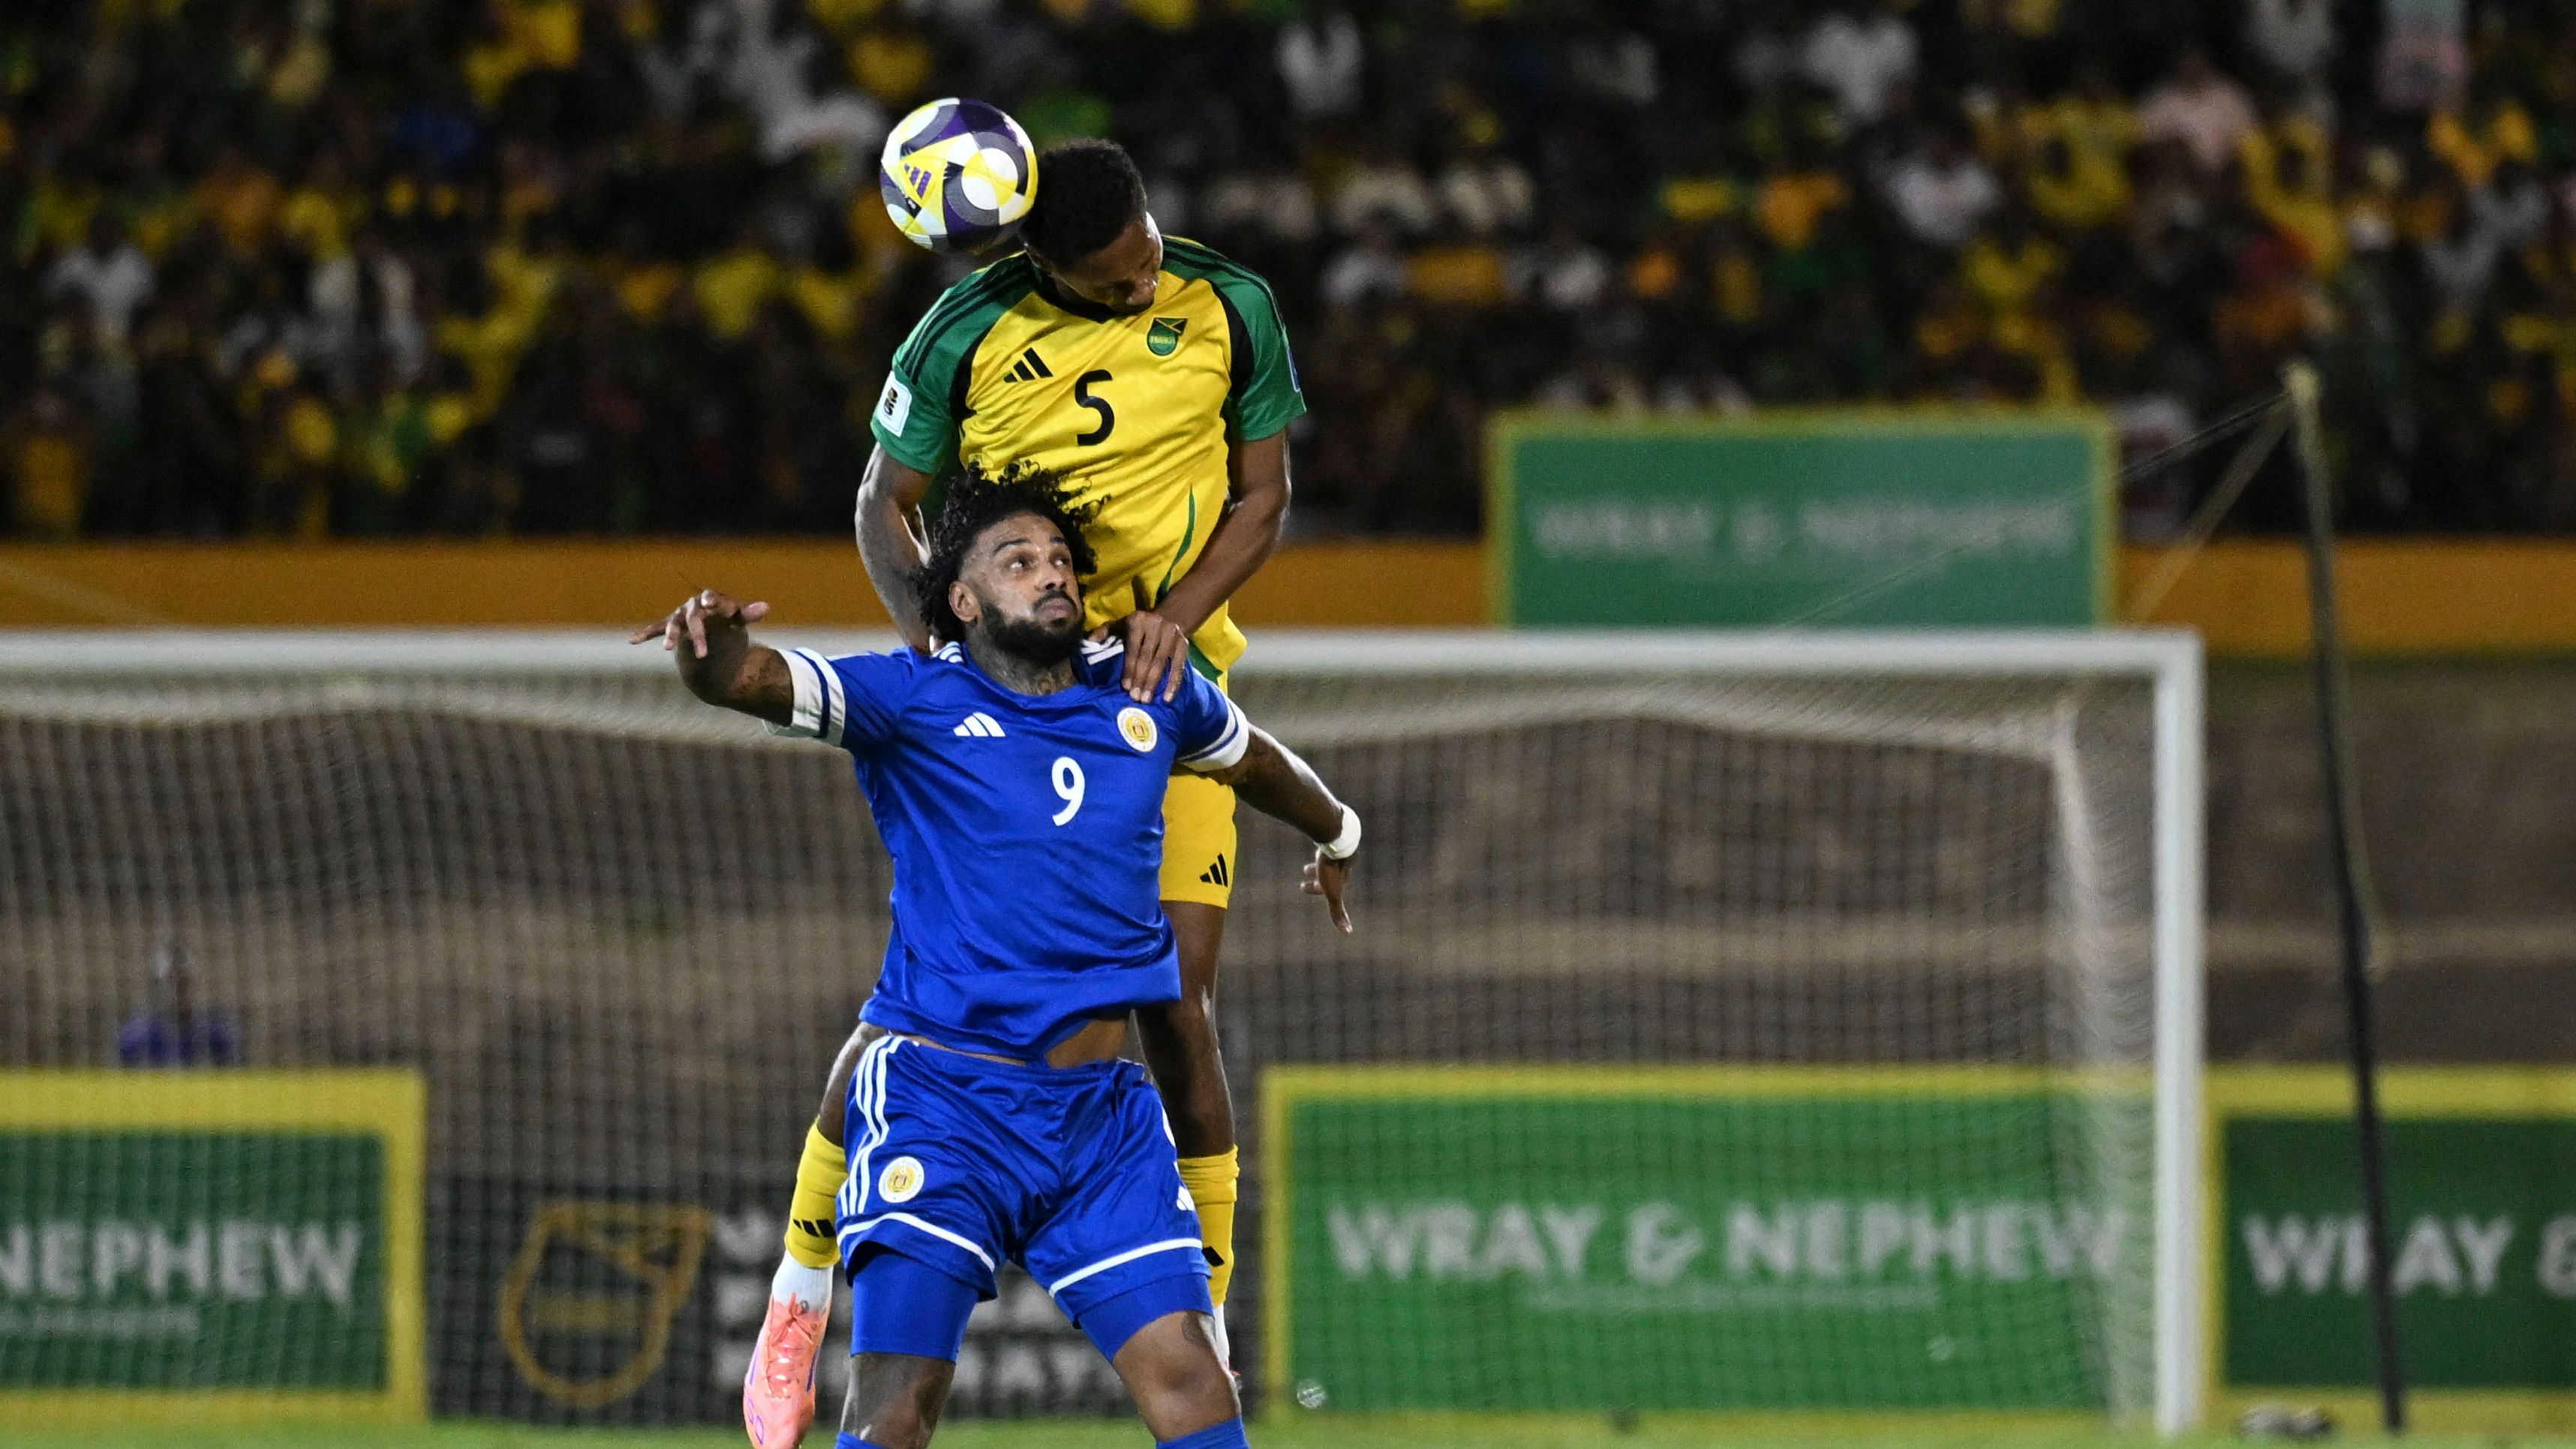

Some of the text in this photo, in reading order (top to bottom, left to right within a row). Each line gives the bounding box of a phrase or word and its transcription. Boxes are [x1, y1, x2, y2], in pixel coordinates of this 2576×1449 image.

[1075, 368, 1115, 446] 5
[1051, 756, 1086, 826] 9
[1327, 1202, 2126, 1284] WRAY & NEPHEW
